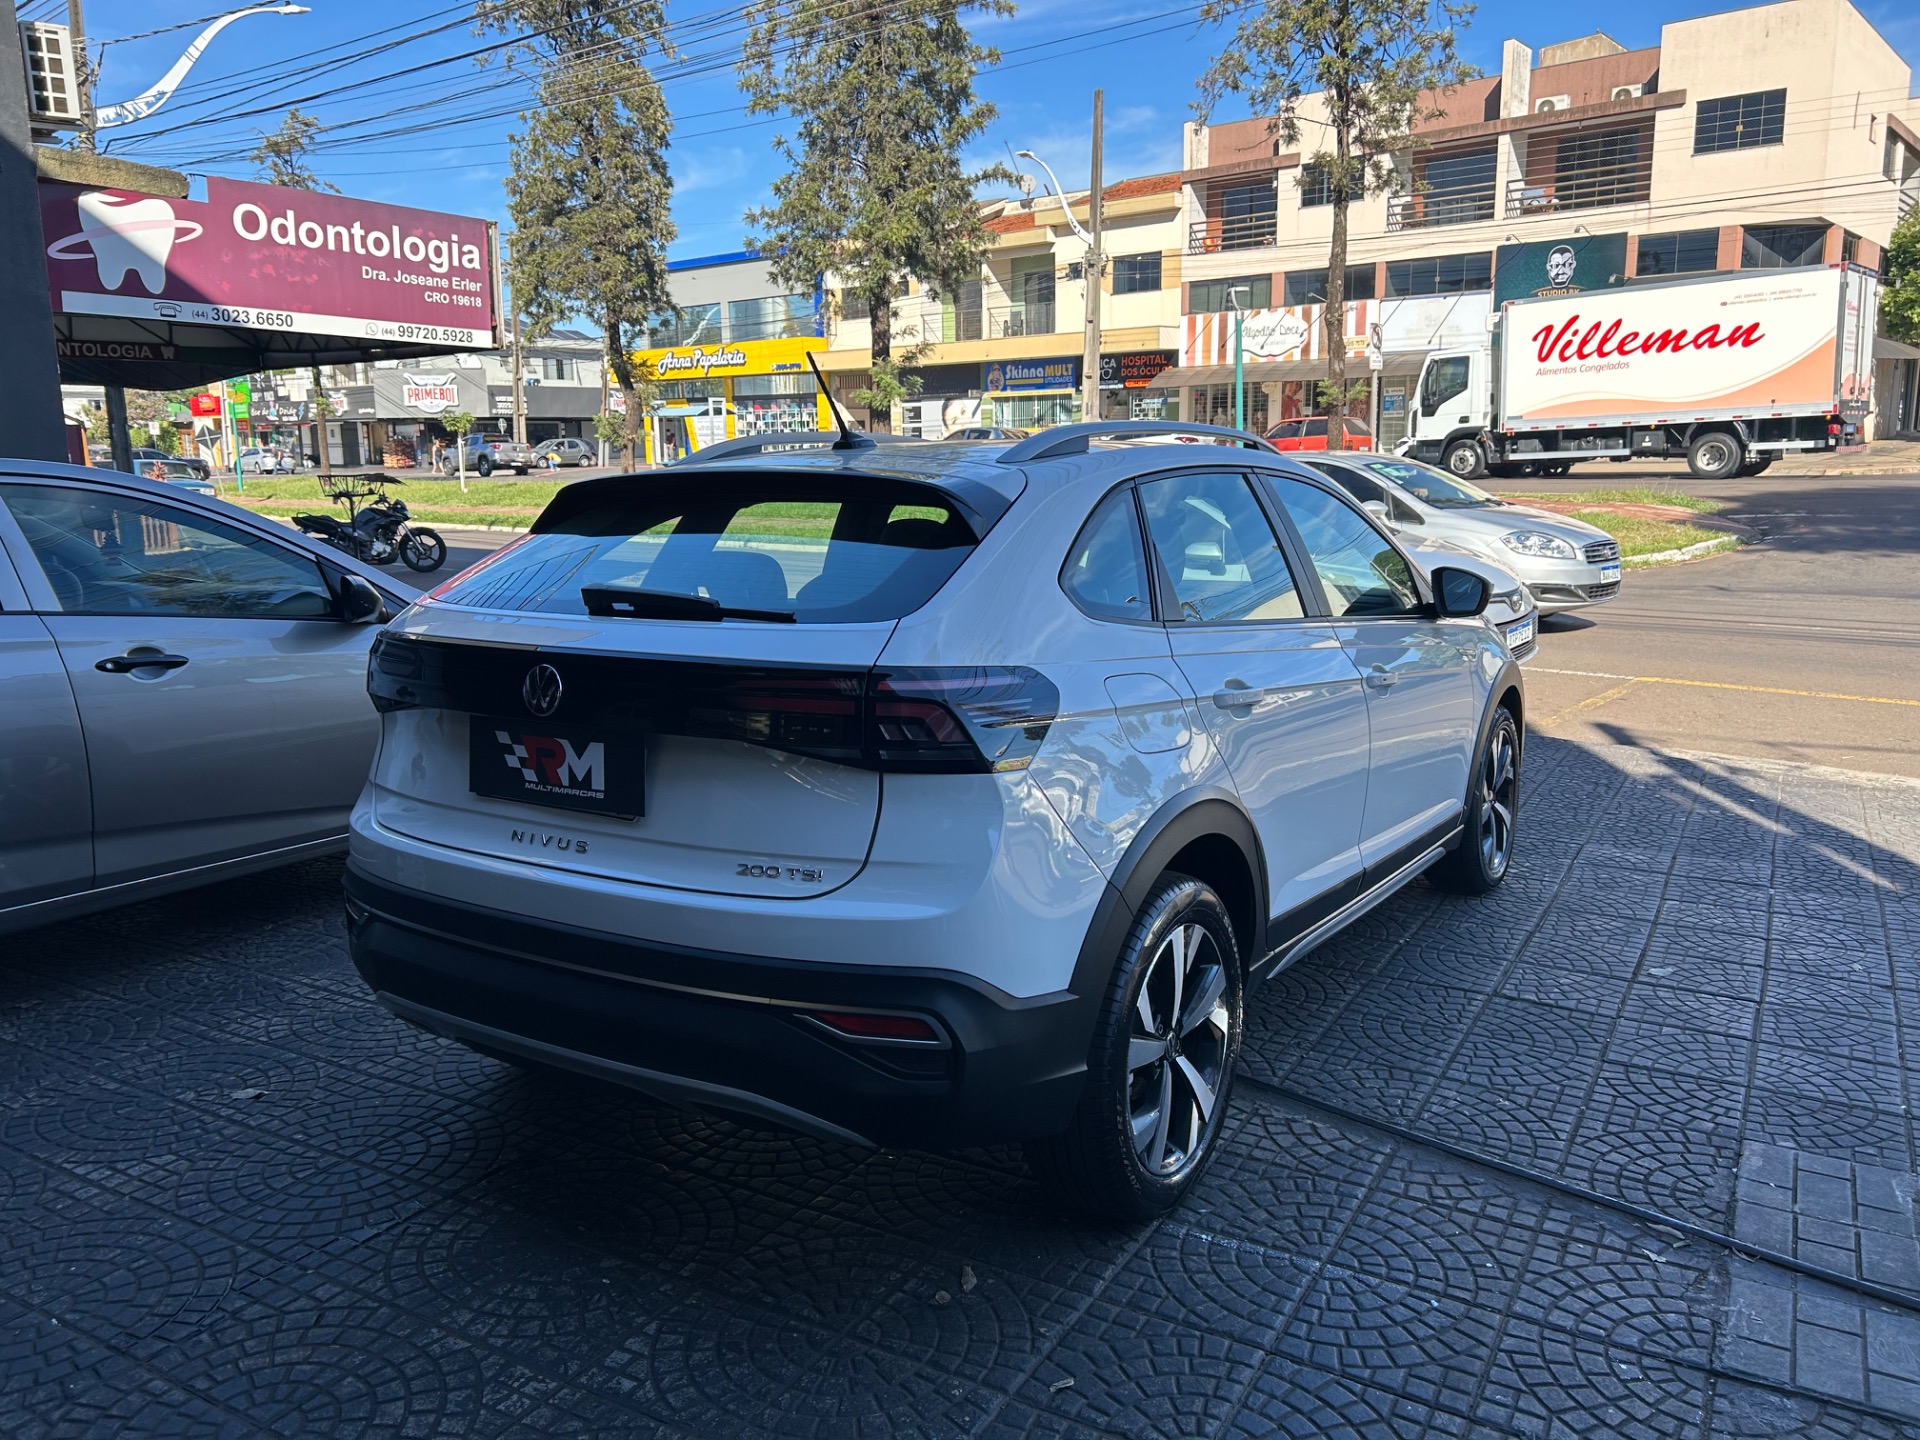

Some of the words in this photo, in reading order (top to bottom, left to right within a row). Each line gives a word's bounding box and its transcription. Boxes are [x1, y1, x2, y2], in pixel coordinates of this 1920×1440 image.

[233, 202, 481, 274] Odontologia
[362, 266, 390, 282] Dra.
[394, 270, 448, 288] Joseane
[452, 277, 482, 292] Erler
[425, 292, 449, 304] CRO
[452, 294, 482, 307] 19618
[1538, 289, 1567, 298] STUDIO
[191, 309, 209, 320] (44)
[211, 307, 293, 328] 3023.6650
[381, 327, 395, 337] (44)
[397, 325, 474, 343] 99720.5928
[1531, 314, 1766, 363] Villeman
[58, 342, 153, 359] NTOLOGIA
[658, 351, 692, 375] Anna
[693, 347, 747, 374] Papelaria
[1100, 358, 1116, 368] ICA
[1121, 354, 1168, 366] HOSPITAL
[1535, 366, 1577, 376] Alimentos
[1579, 360, 1630, 373] Congelados
[1006, 364, 1044, 379] Skinna
[1045, 364, 1073, 376] MULT
[1121, 368, 1137, 376] DOS
[407, 387, 455, 403] PRIMEBOI
[521, 735, 605, 791] RM
[525, 782, 605, 799] MULTIMARCAS
[511, 829, 589, 854] NIVUS
[736, 863, 781, 878] 200
[787, 867, 824, 882] TSI
